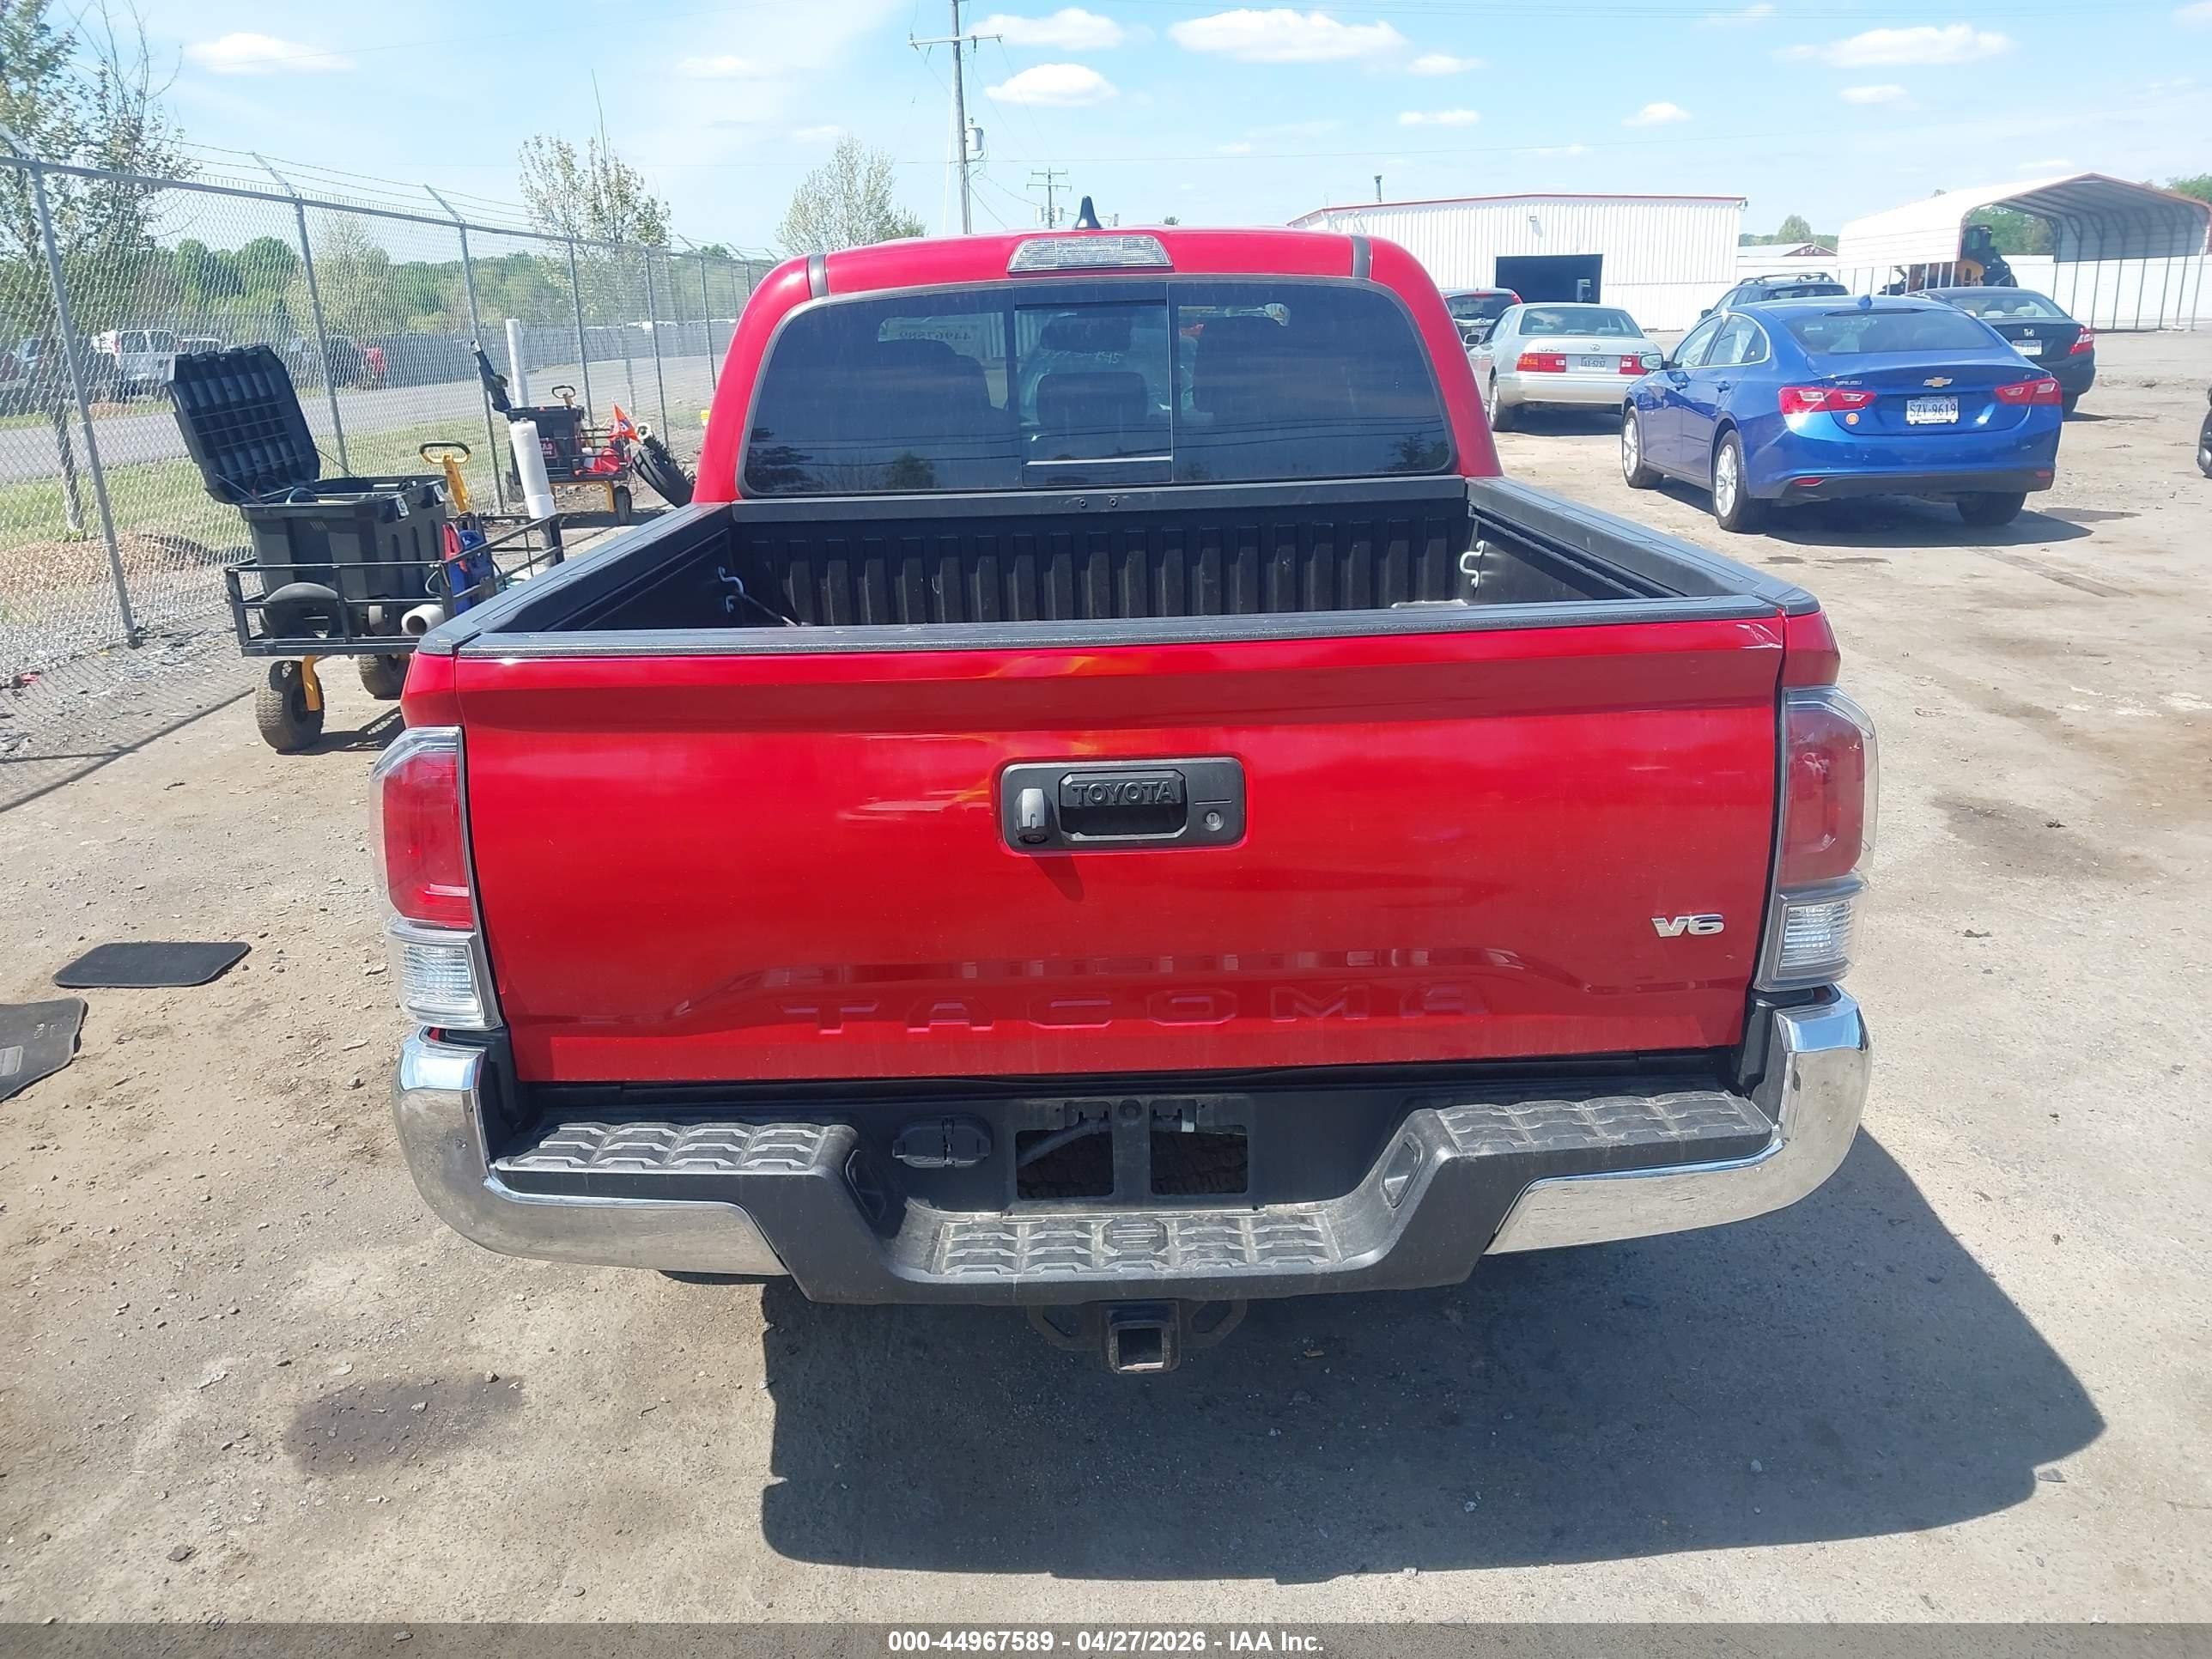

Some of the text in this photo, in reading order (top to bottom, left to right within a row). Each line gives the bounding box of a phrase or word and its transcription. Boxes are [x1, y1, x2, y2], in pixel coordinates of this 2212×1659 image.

[1071, 781, 1176, 805] TOYOTA
[1650, 914, 1725, 938] V6
[781, 981, 1492, 1036] TACOMA
